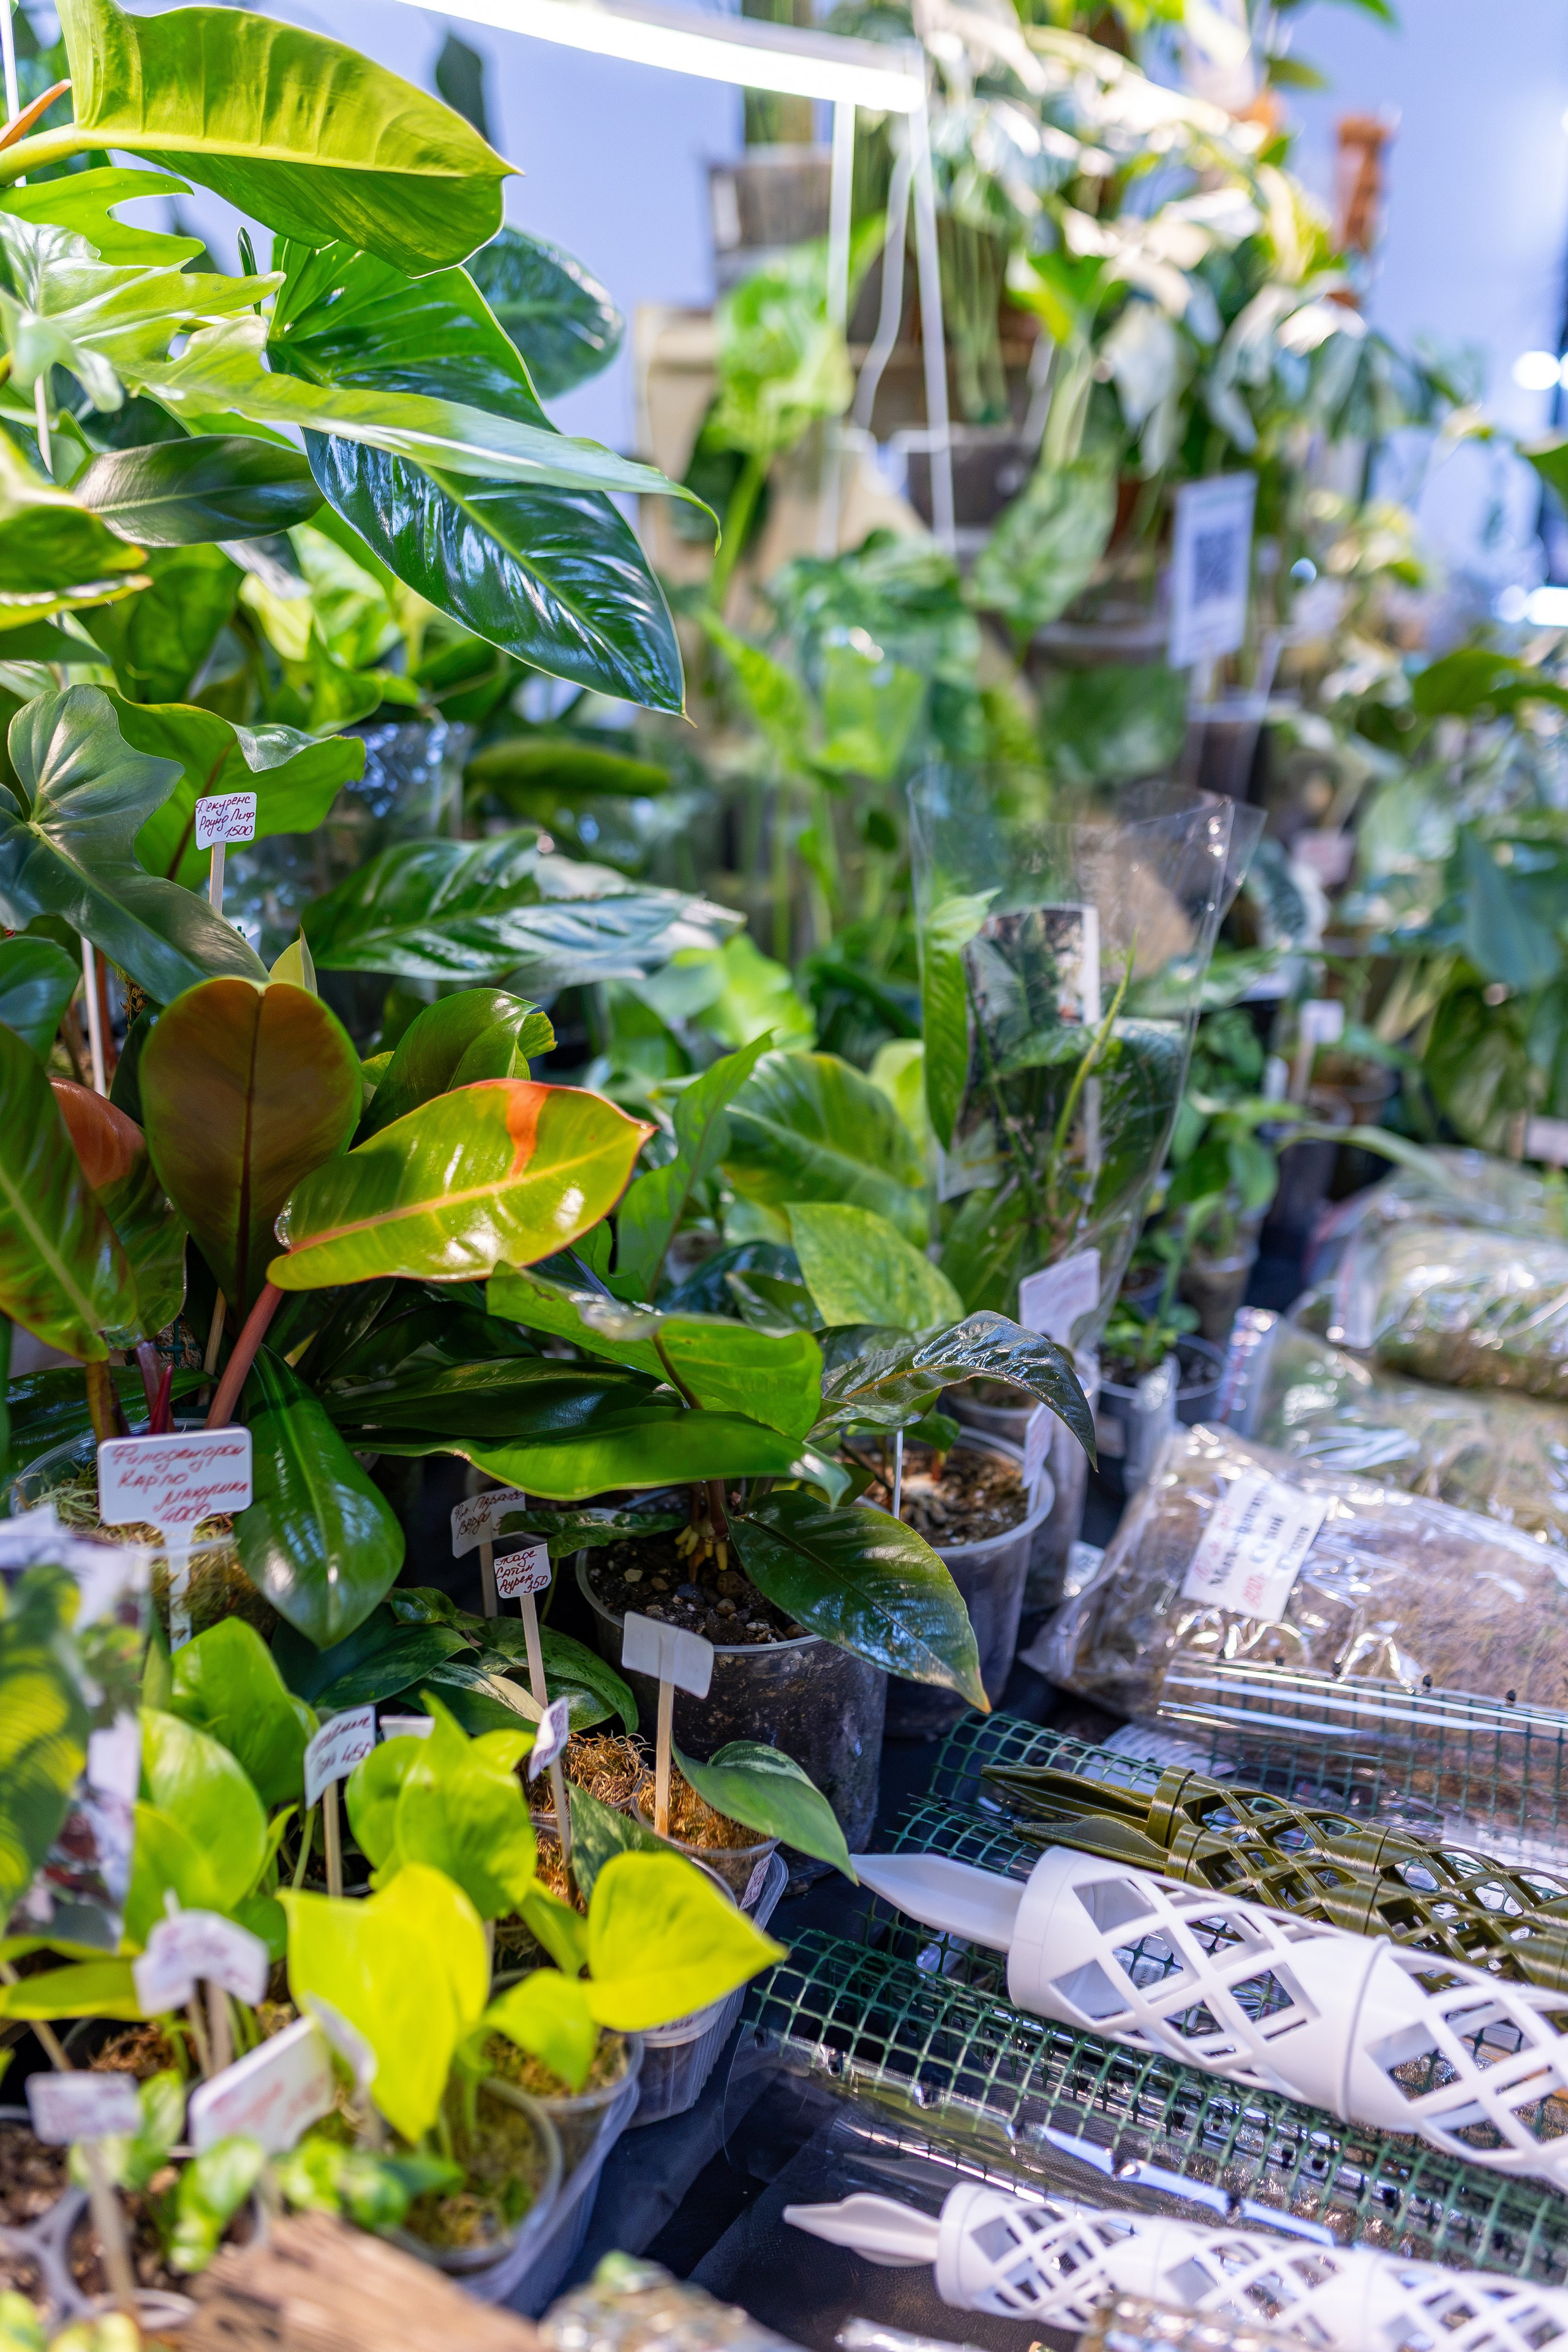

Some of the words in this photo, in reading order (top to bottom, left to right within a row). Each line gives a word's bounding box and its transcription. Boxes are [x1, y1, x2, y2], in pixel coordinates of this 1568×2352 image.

[195, 796, 251, 816] Декуренс
[199, 815, 228, 837] Раунд
[230, 808, 255, 822] Лиф
[224, 824, 253, 837] 1500
[523, 1575, 548, 1593] 350
